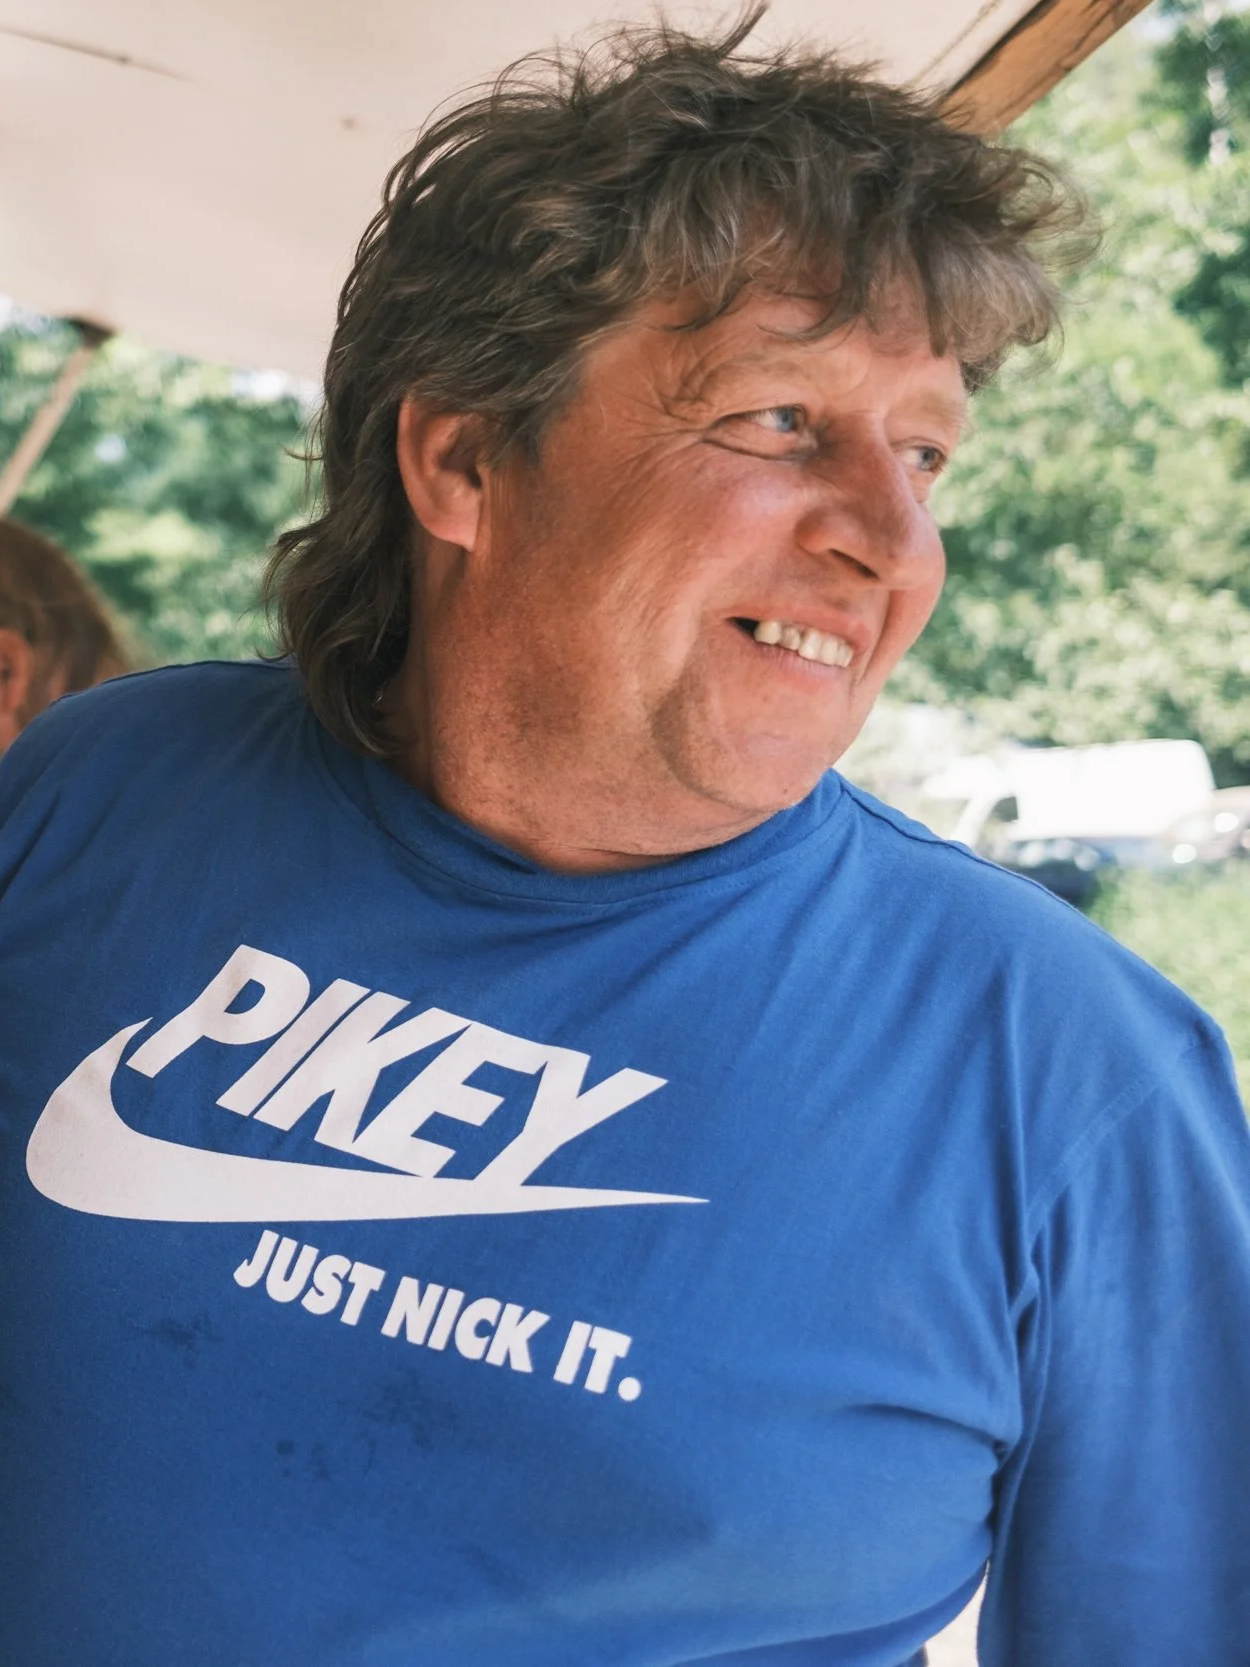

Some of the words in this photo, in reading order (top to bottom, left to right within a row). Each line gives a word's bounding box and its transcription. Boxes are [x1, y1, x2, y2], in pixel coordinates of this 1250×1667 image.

[126, 944, 669, 1187] PIKEY
[233, 1229, 386, 1326] JUST
[380, 1276, 550, 1373] NICK
[553, 1320, 642, 1401] IT.
